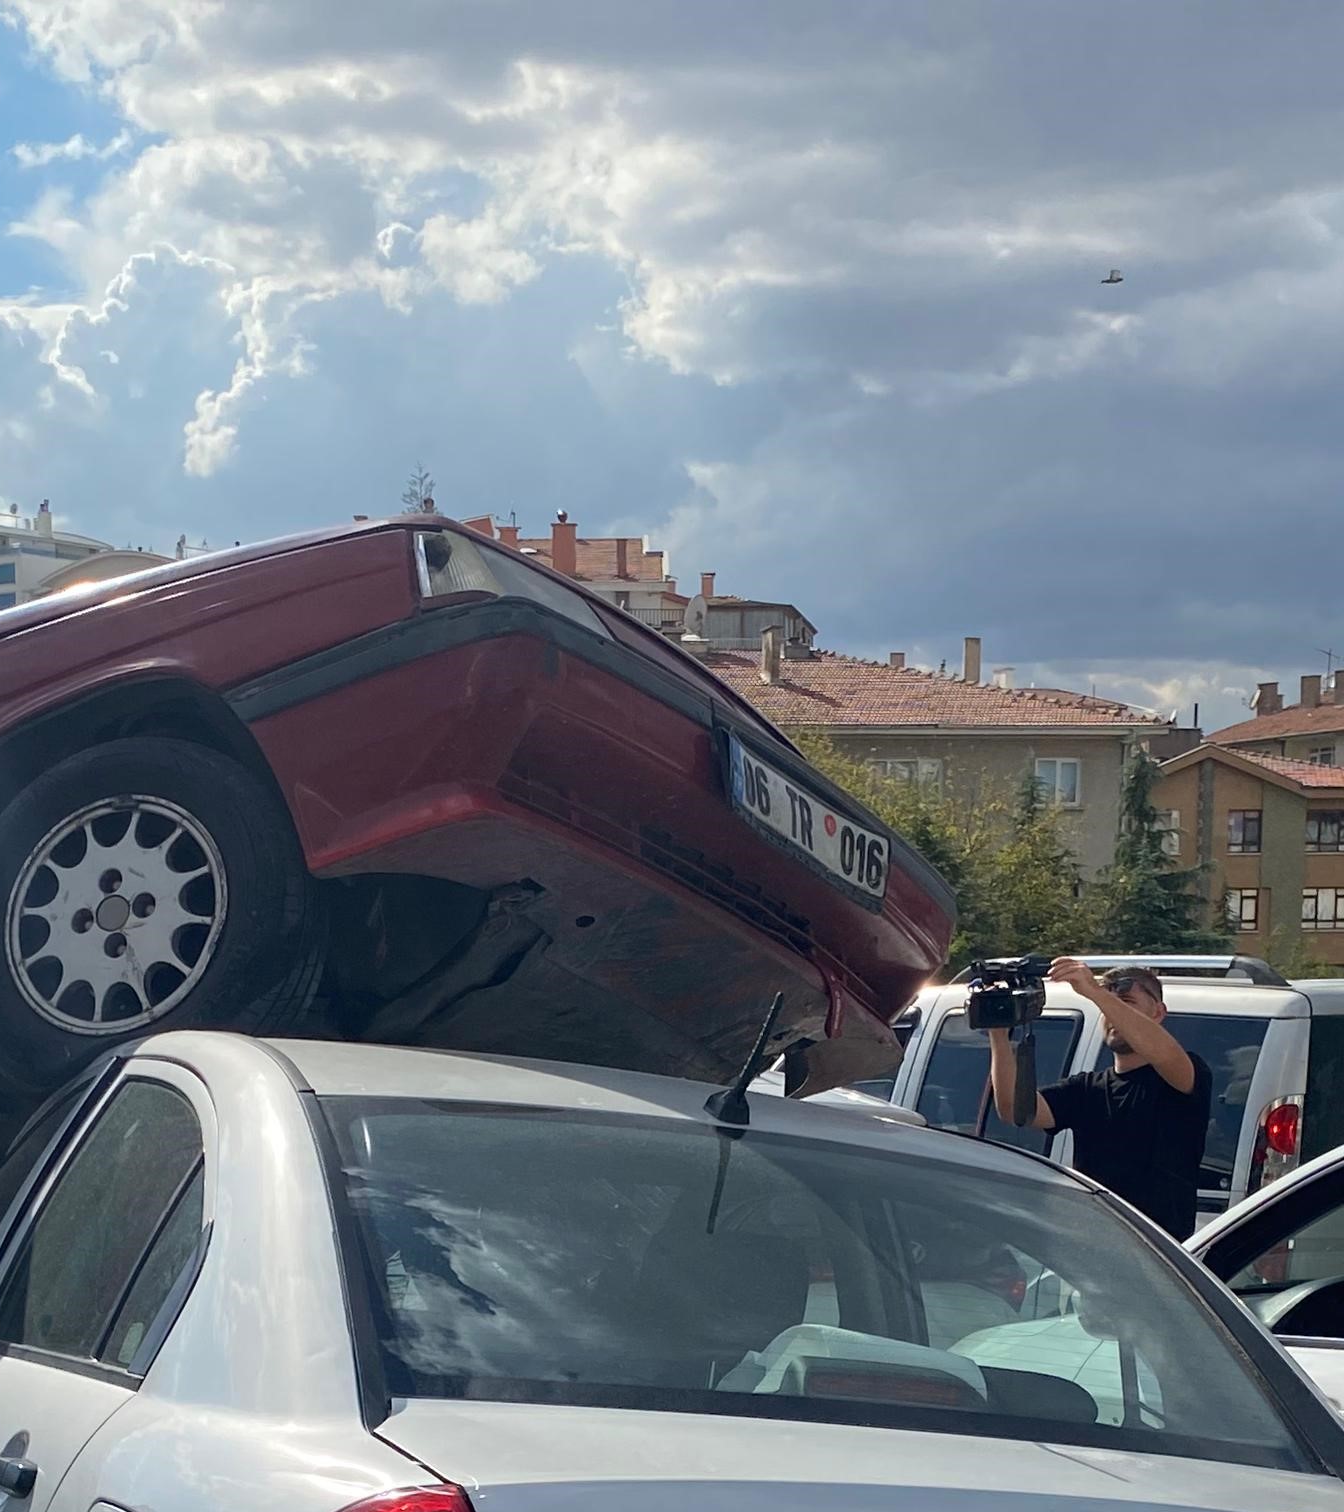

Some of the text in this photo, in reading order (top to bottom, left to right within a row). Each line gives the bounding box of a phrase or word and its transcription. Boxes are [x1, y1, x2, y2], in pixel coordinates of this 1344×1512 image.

[743, 754, 884, 890] 06 TR 016
